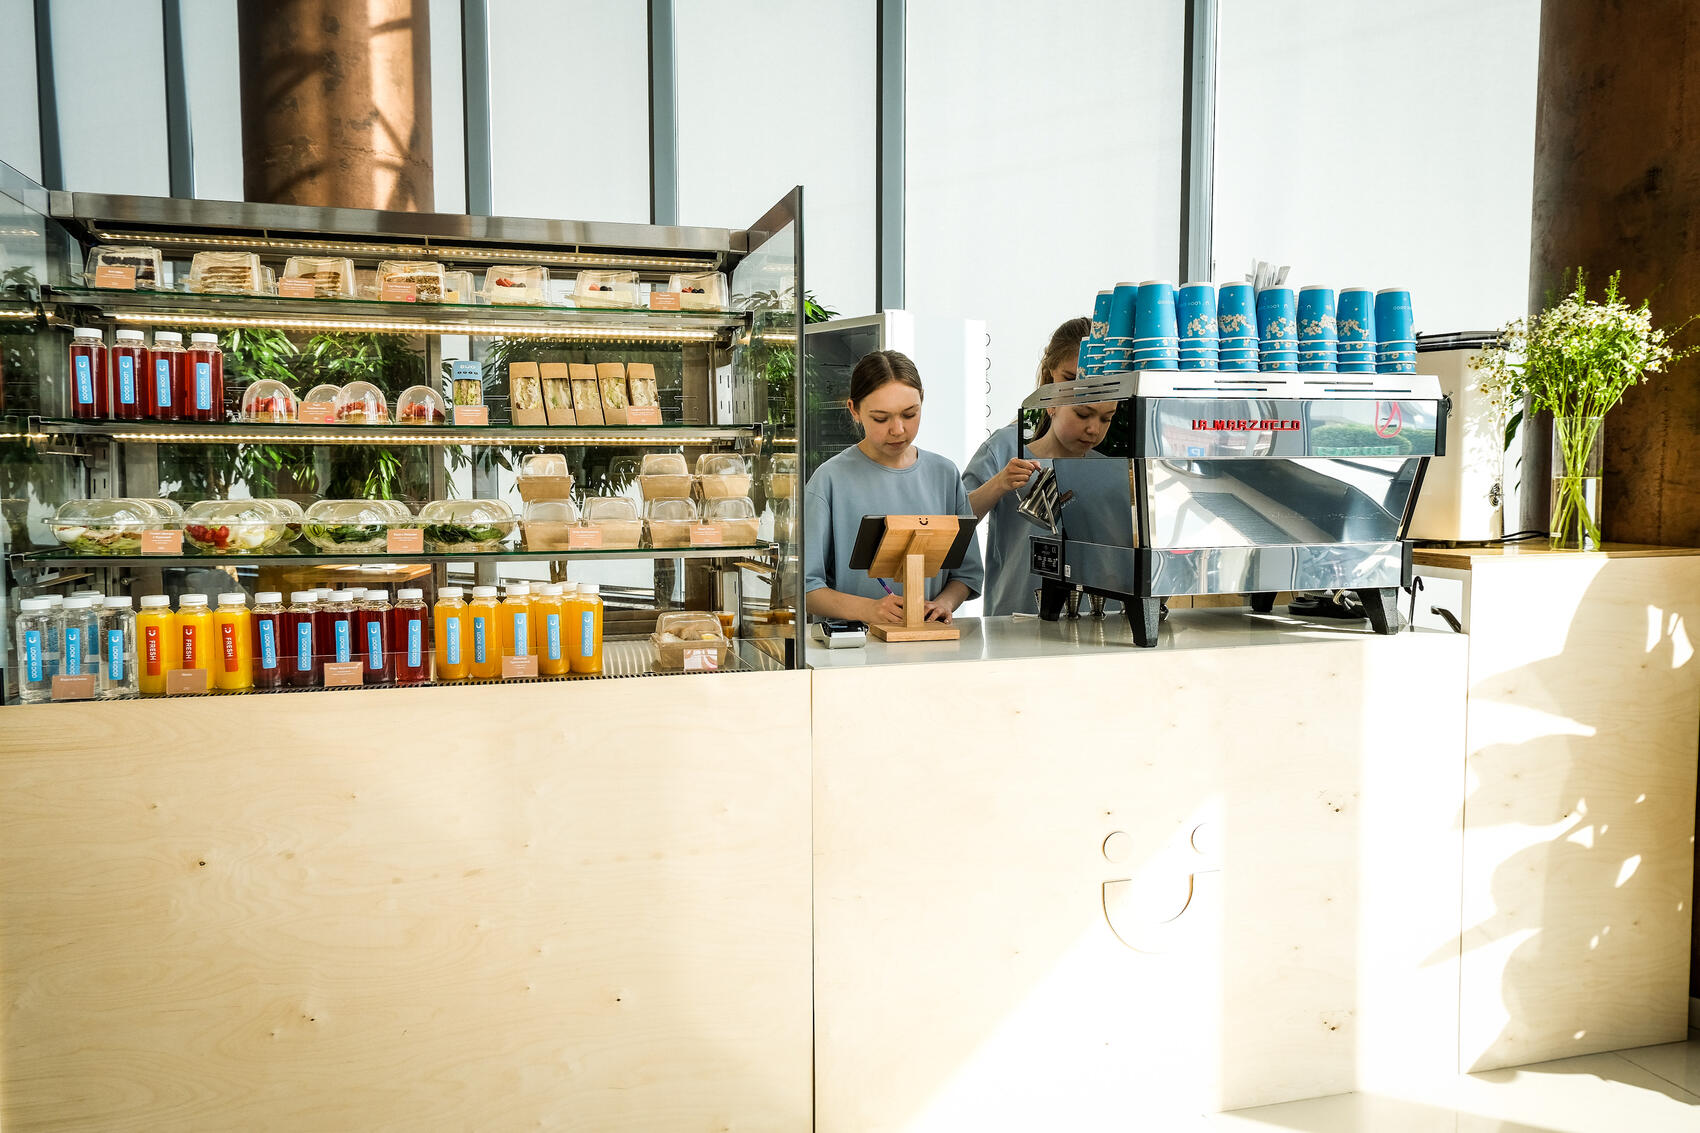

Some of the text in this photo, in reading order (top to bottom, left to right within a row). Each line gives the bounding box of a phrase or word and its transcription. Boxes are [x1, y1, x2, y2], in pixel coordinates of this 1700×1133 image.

[1192, 419, 1300, 431] LA MARZOCCO
[30, 647, 38, 660] LOOK
